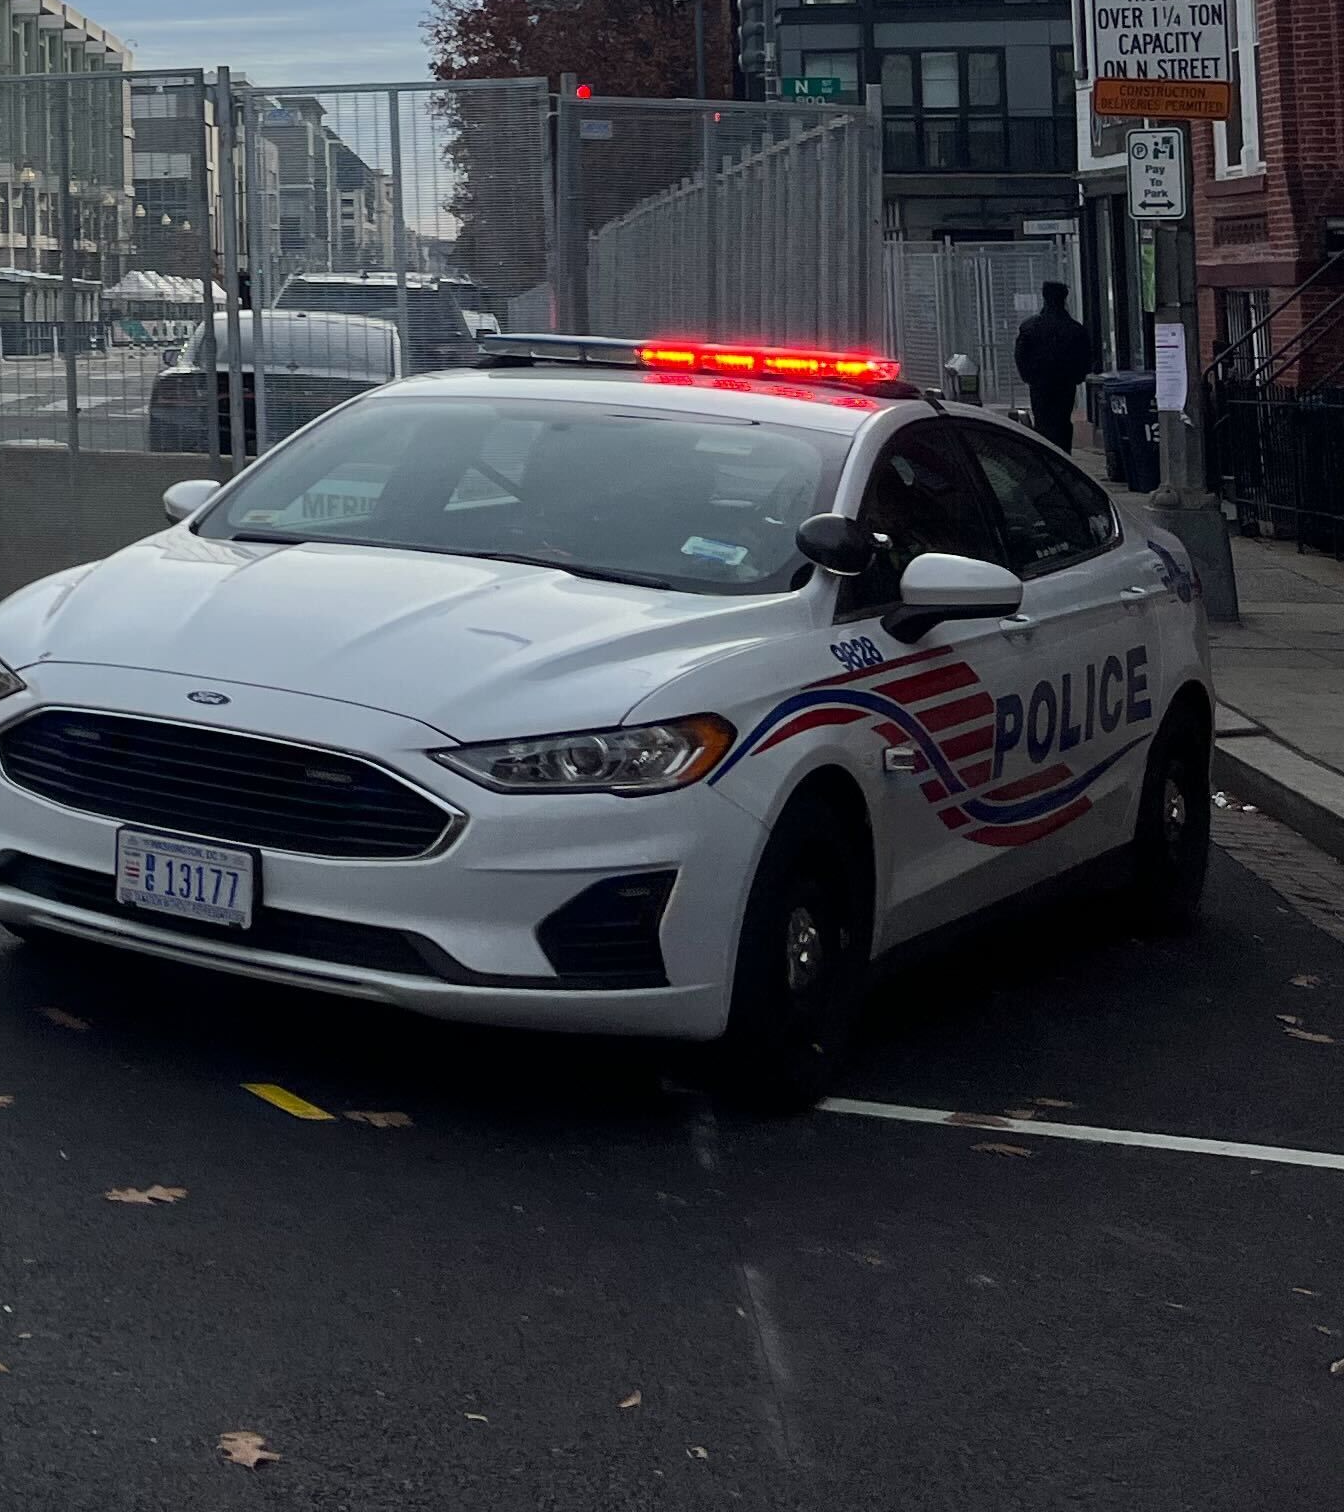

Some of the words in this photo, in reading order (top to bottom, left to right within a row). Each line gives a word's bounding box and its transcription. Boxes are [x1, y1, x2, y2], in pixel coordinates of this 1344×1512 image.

[1098, 7, 1143, 29] OVER
[1188, 3, 1223, 26] TON
[1119, 31, 1202, 55] CAPACITY
[1104, 59, 1127, 78] ON
[1137, 59, 1147, 78] N
[1157, 57, 1220, 79] STREET
[795, 80, 808, 94] N
[1120, 84, 1206, 99] CONSTRUCTION
[1100, 97, 1161, 112] DELIVERIES
[1164, 99, 1223, 113] PERMITTED
[1145, 165, 1165, 175] Pay
[1150, 178, 1162, 186] To
[1144, 189, 1169, 198] Park
[830, 635, 884, 672] 9828
[992, 644, 1153, 780] POLICE
[164, 859, 239, 908] 13177
